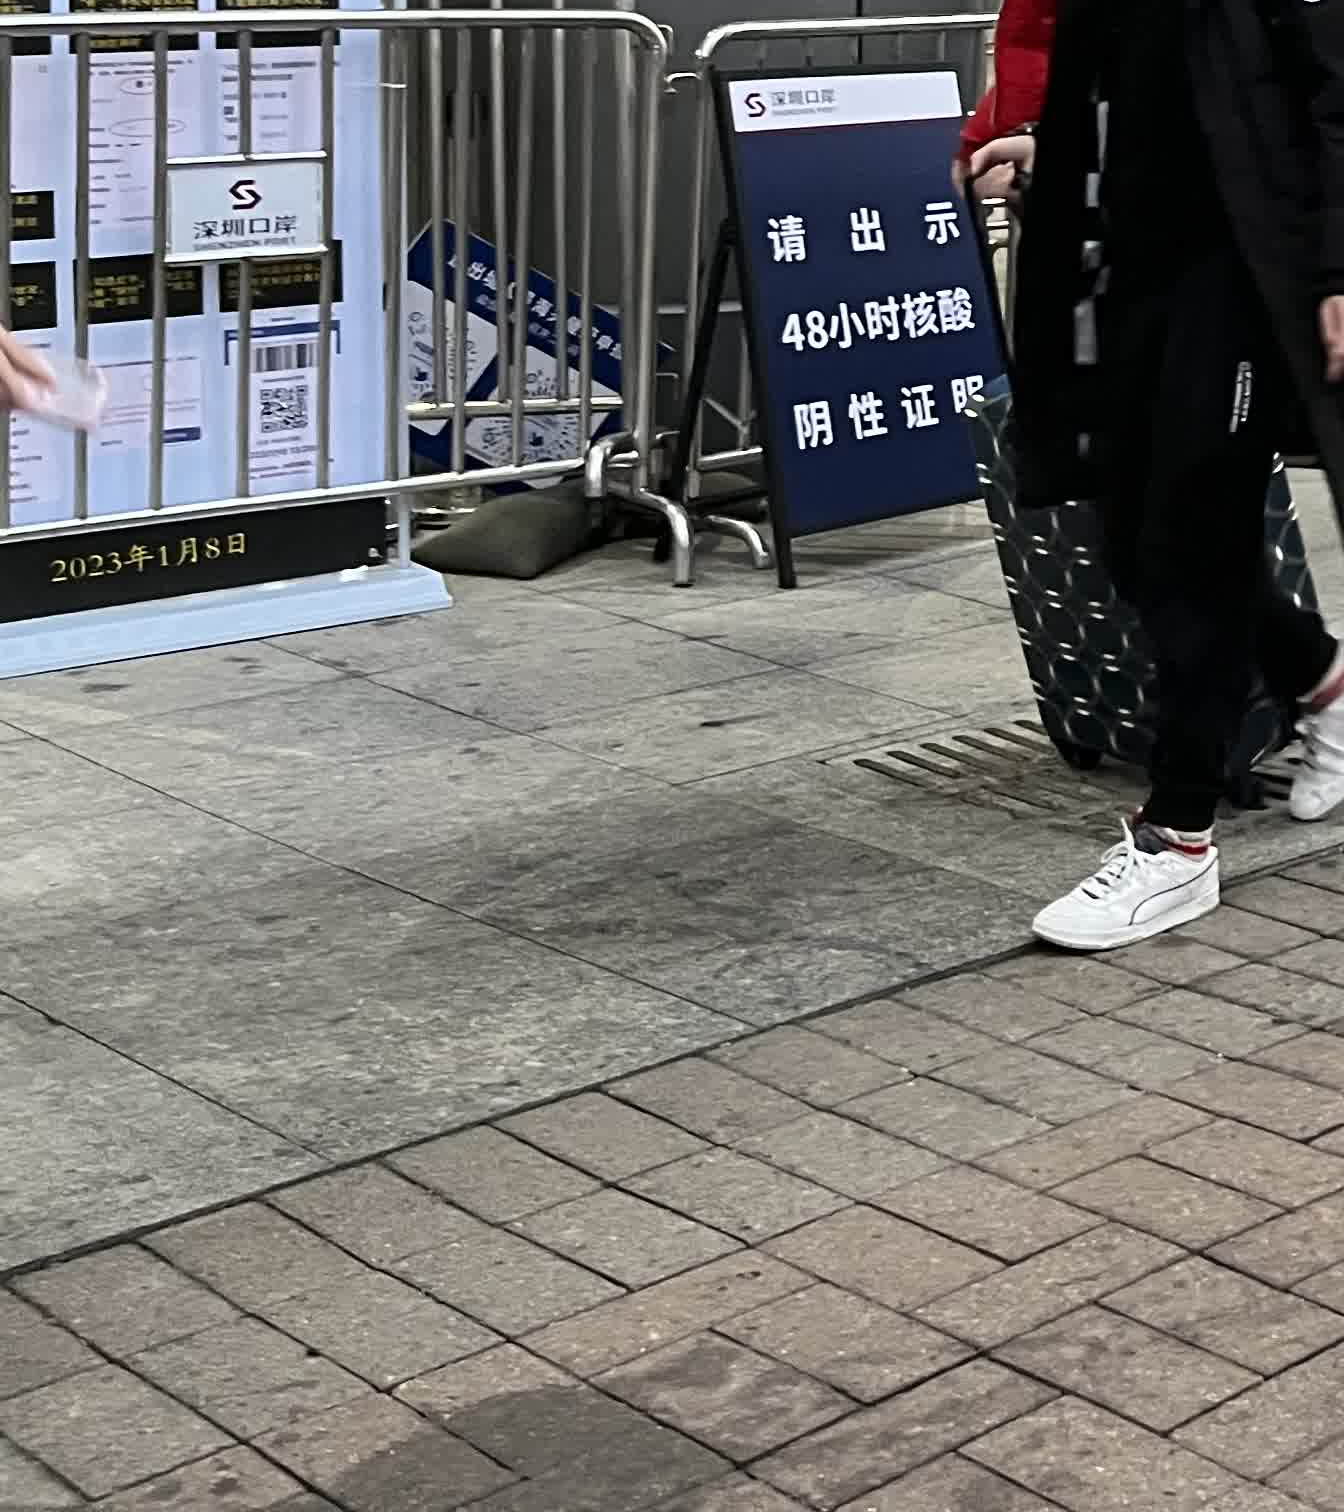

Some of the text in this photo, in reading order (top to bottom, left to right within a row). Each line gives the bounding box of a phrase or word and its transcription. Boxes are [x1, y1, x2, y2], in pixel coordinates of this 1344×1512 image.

[193, 215, 297, 240] 深圳口岸
[781, 286, 977, 351] 48小时核酸
[50, 532, 248, 583] 2023年1月8日
